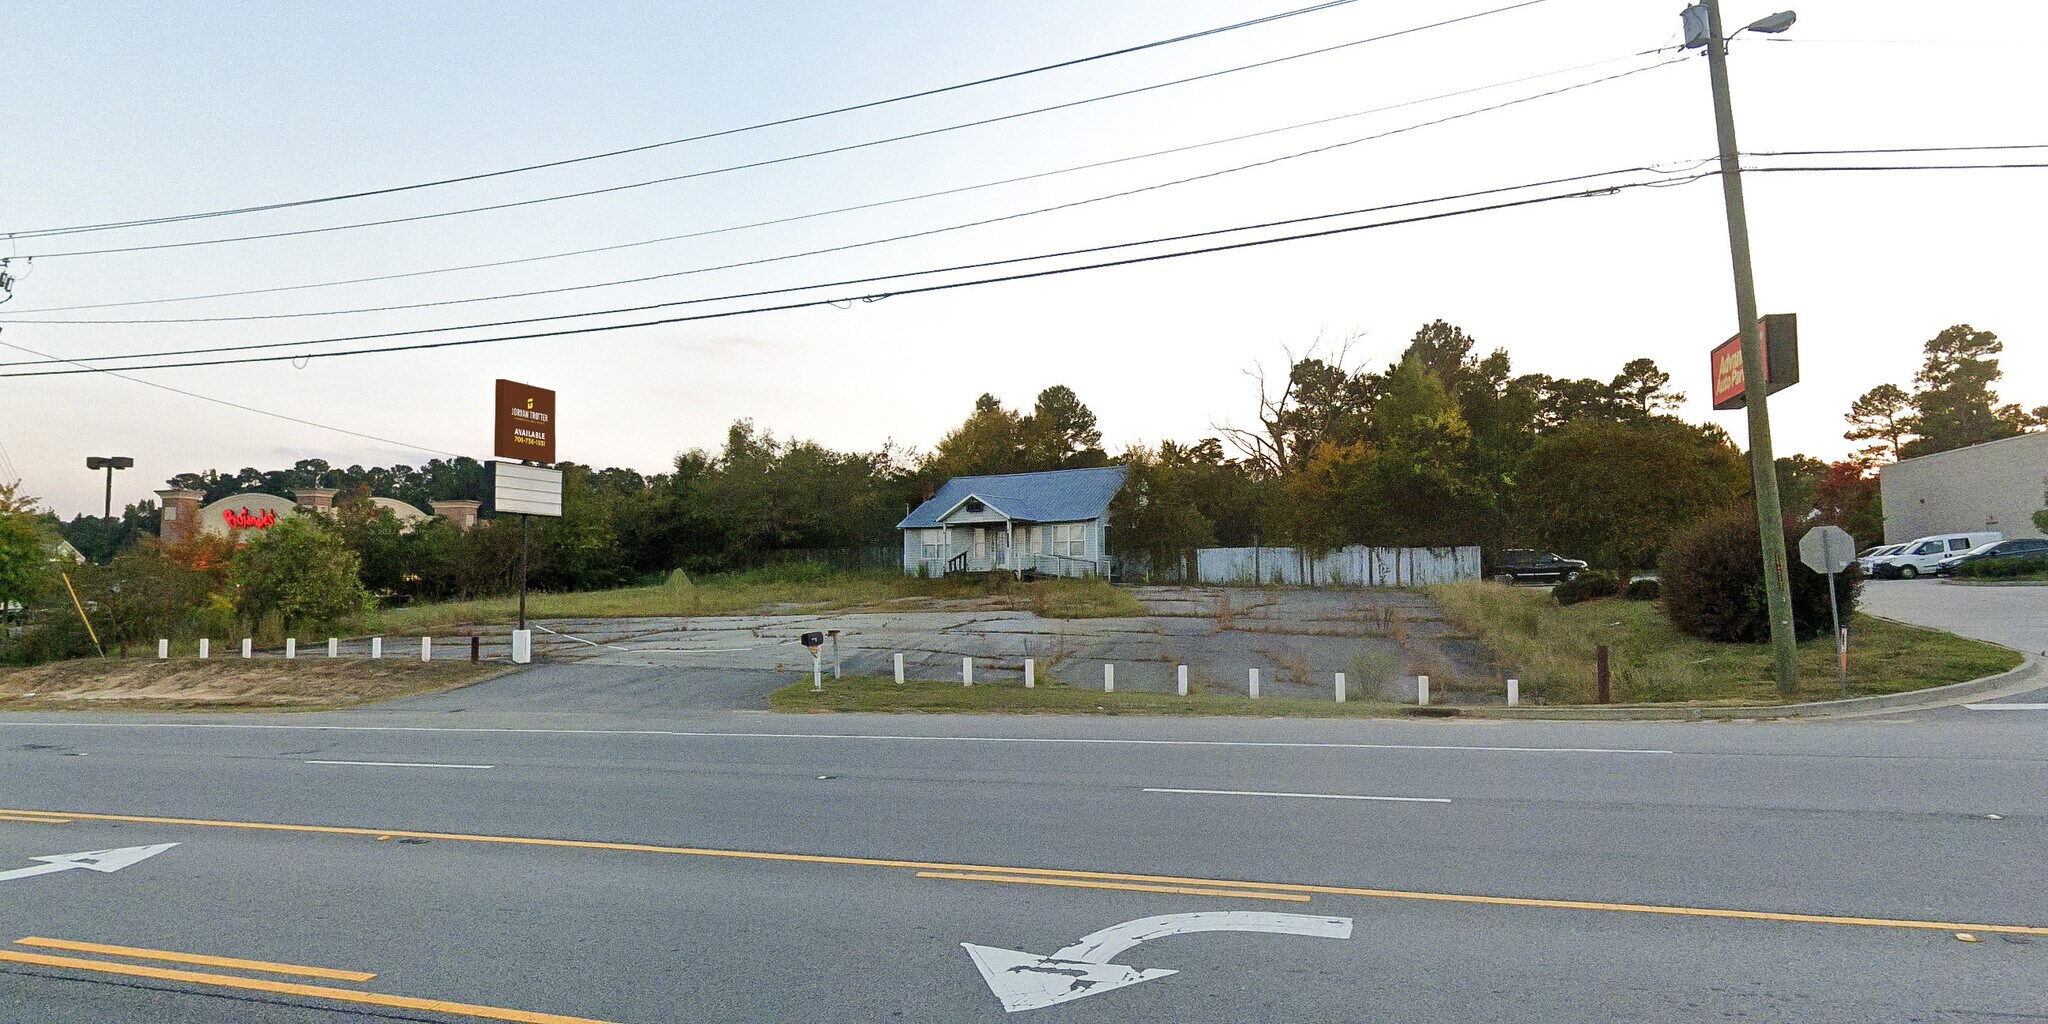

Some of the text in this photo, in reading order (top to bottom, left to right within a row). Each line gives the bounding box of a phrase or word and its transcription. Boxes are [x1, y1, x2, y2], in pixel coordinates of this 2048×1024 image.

[1716, 374, 1732, 396] Auto
[511, 407, 529, 419] JORDAN
[529, 410, 549, 423] TROTTER
[514, 428, 546, 440] AVAILABLE
